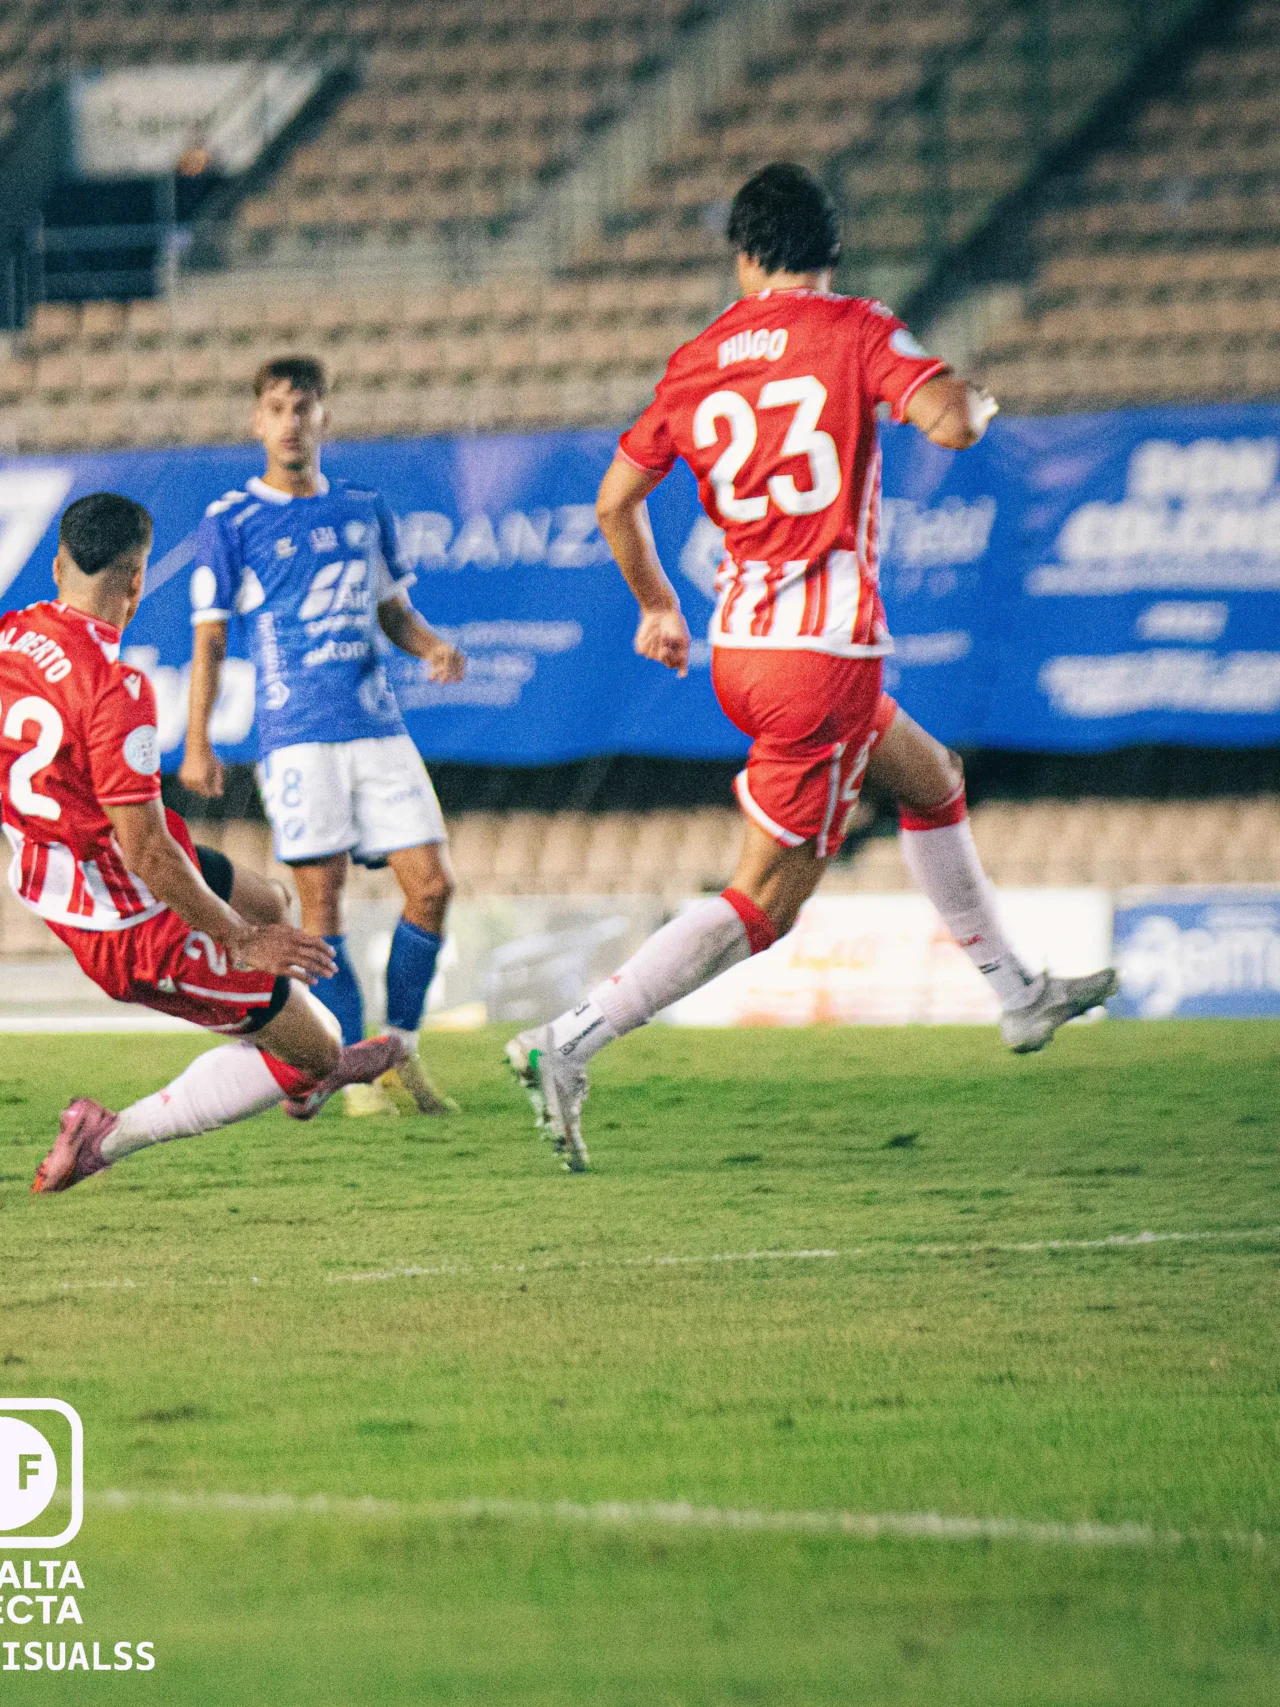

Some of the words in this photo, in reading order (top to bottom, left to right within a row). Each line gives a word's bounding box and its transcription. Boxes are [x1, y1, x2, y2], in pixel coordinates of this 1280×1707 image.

[718, 328, 788, 369] HUGO
[693, 375, 842, 521] 23
[281, 767, 303, 808] 8
